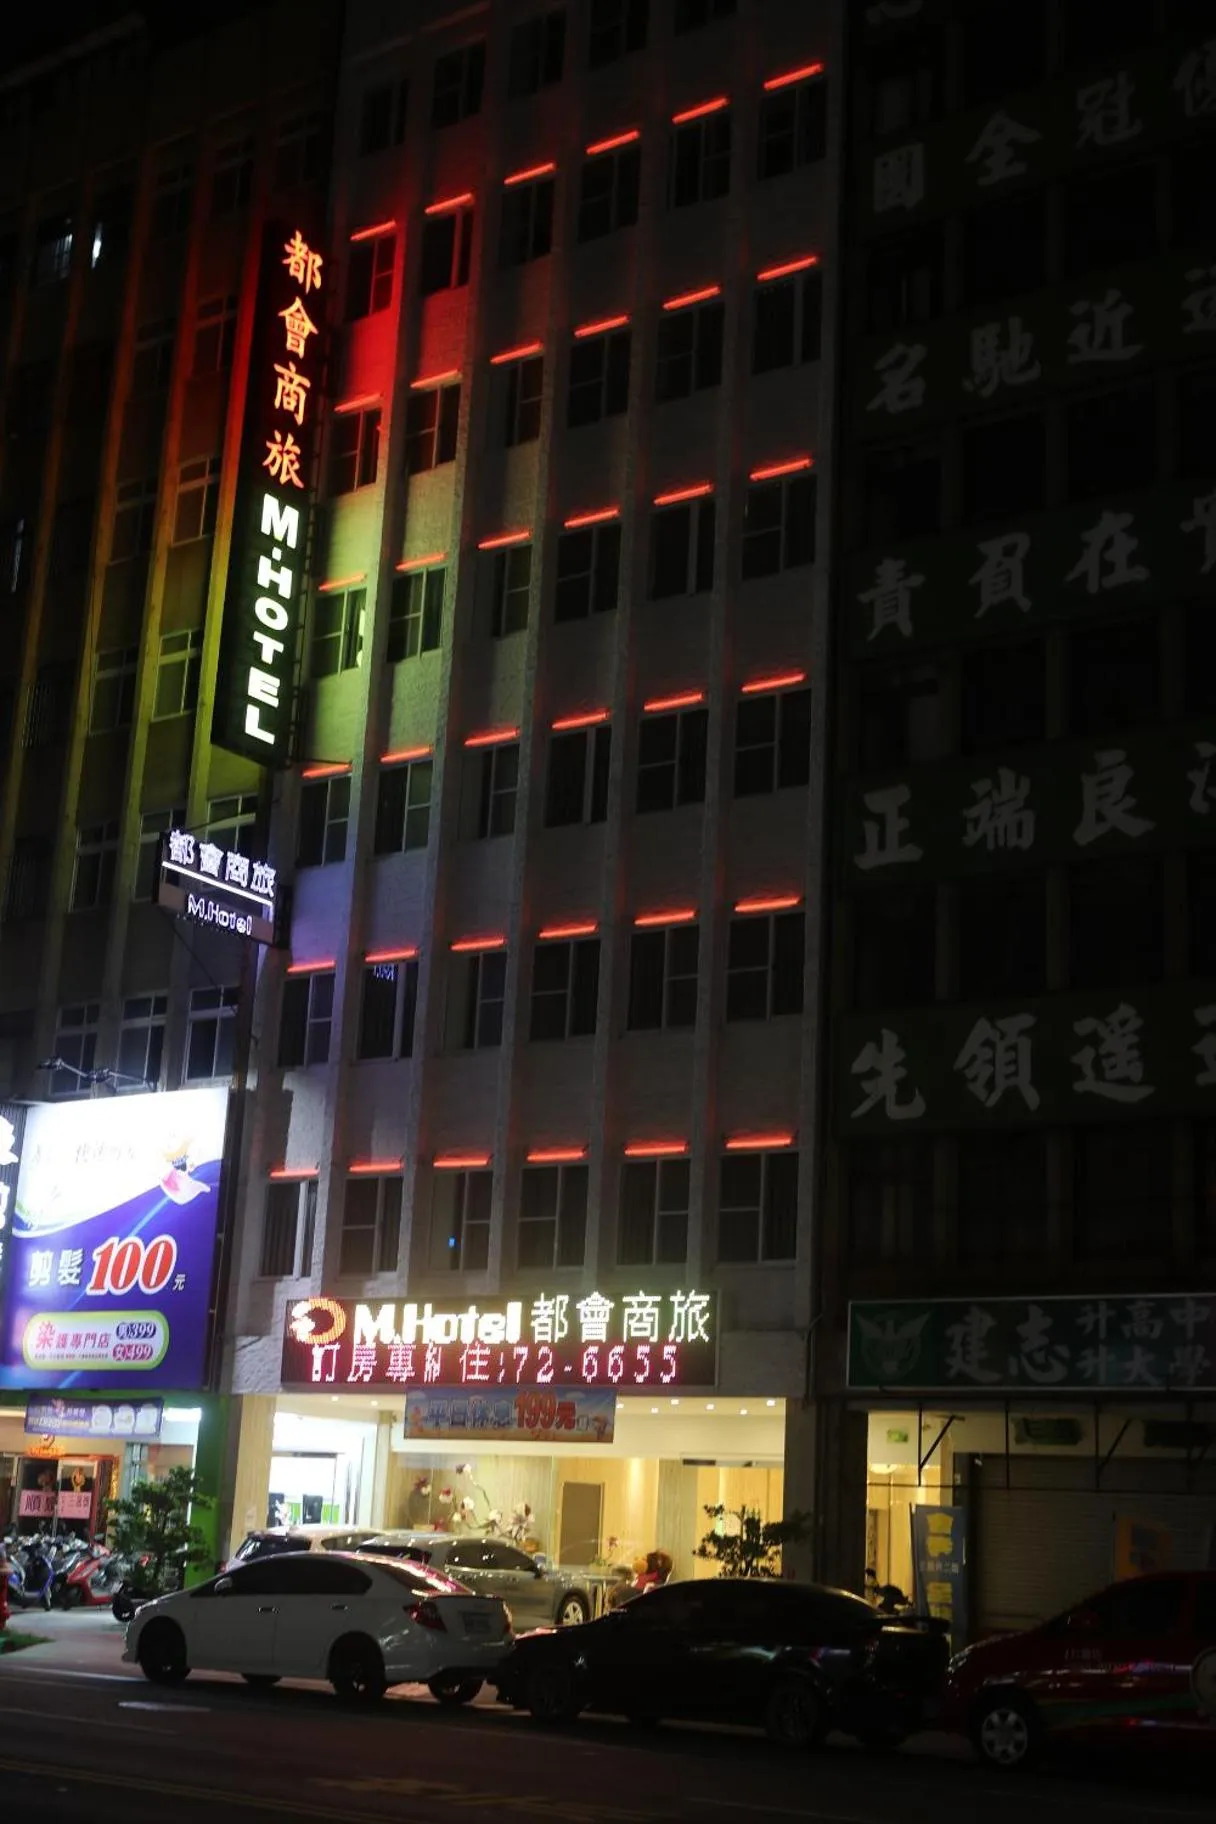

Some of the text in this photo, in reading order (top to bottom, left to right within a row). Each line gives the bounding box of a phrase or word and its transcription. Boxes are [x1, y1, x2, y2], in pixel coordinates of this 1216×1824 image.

[262, 229, 324, 489] 都會商旅
[187, 893, 253, 936] M.Hotel
[87, 1235, 177, 1296] 100
[353, 1290, 710, 1345] M.Hotel 都會商旅
